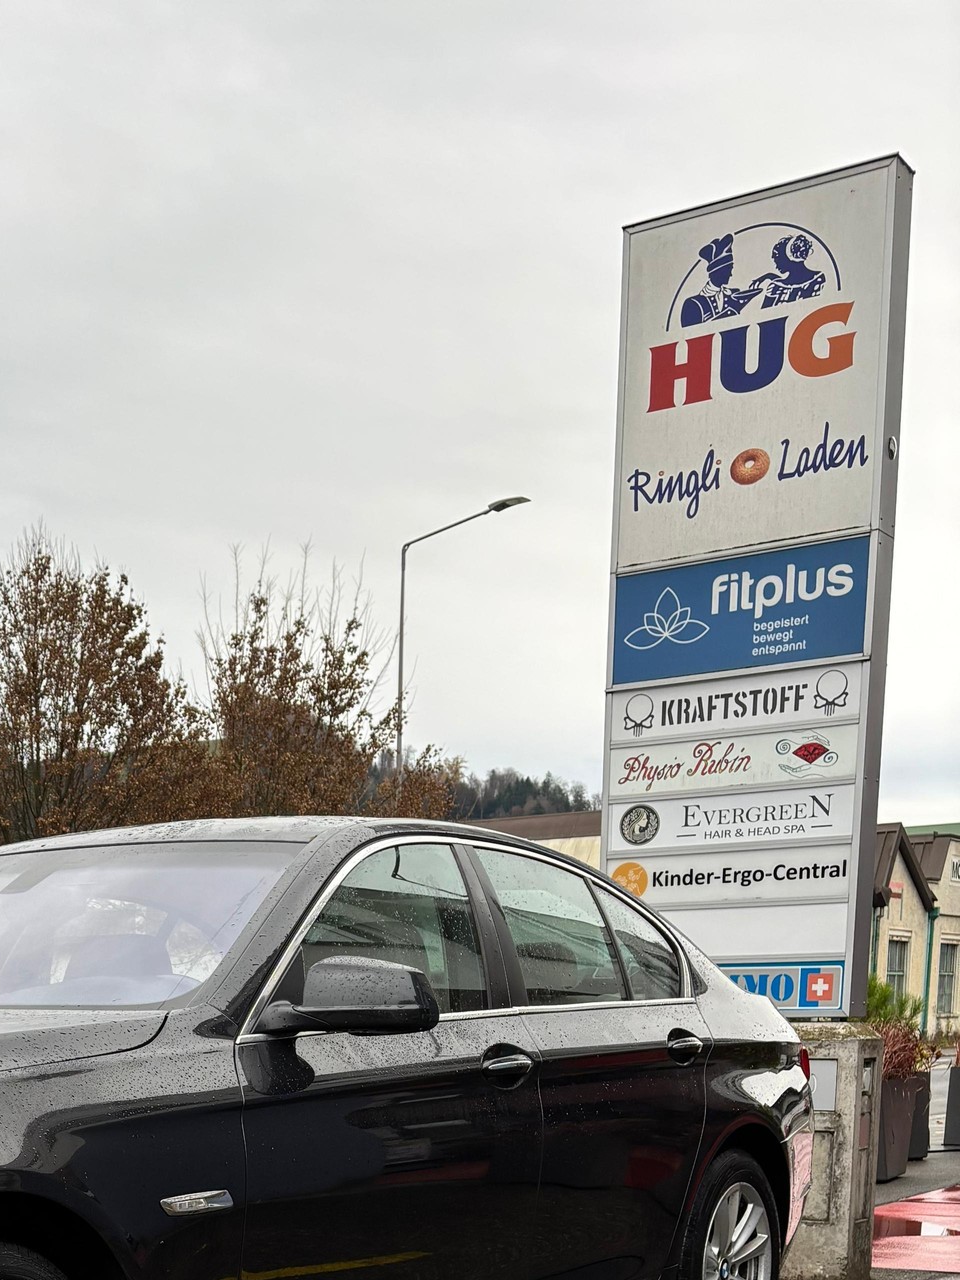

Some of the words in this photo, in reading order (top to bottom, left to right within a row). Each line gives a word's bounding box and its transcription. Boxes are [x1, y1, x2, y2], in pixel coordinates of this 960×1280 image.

[646, 301, 857, 413] HUG
[627, 445, 721, 519] Ringli
[777, 421, 869, 481] Laden
[711, 563, 854, 618] fitplus
[752, 629, 793, 644] bewegt
[753, 614, 809, 632] begeistert
[751, 640, 807, 656] entspannt
[660, 683, 809, 727] KRAFTSTOFF
[618, 753, 685, 792] Physio
[686, 741, 752, 777] Rubin
[704, 829, 732, 840] HAIR
[734, 828, 744, 838] &
[747, 825, 781, 837] HEAD
[783, 823, 806, 834] SPA
[652, 859, 848, 888] Kinder-Ergo-Central
